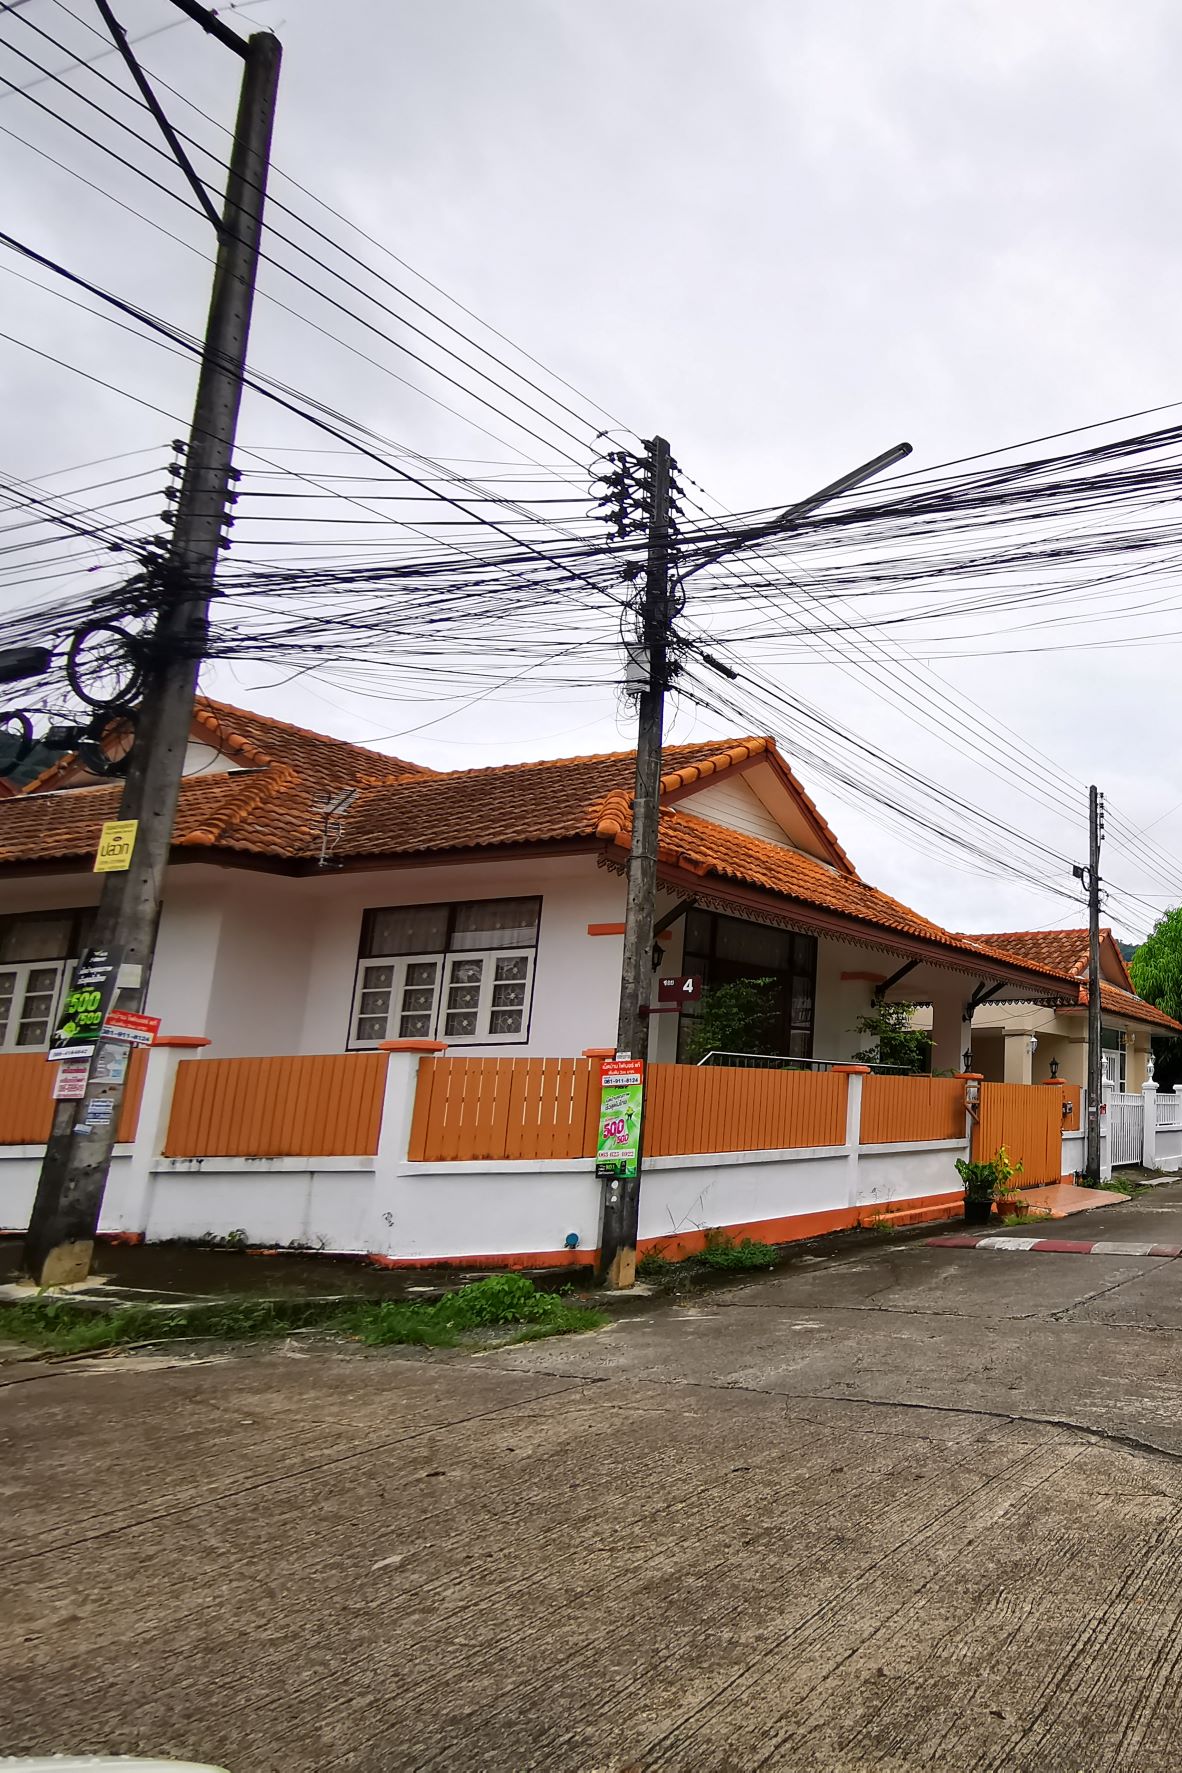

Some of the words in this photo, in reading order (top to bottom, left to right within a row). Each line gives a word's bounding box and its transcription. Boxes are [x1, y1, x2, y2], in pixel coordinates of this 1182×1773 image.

[682, 978, 694, 993] 4
[68, 991, 101, 1014] 500
[602, 1118, 625, 1139] 500
